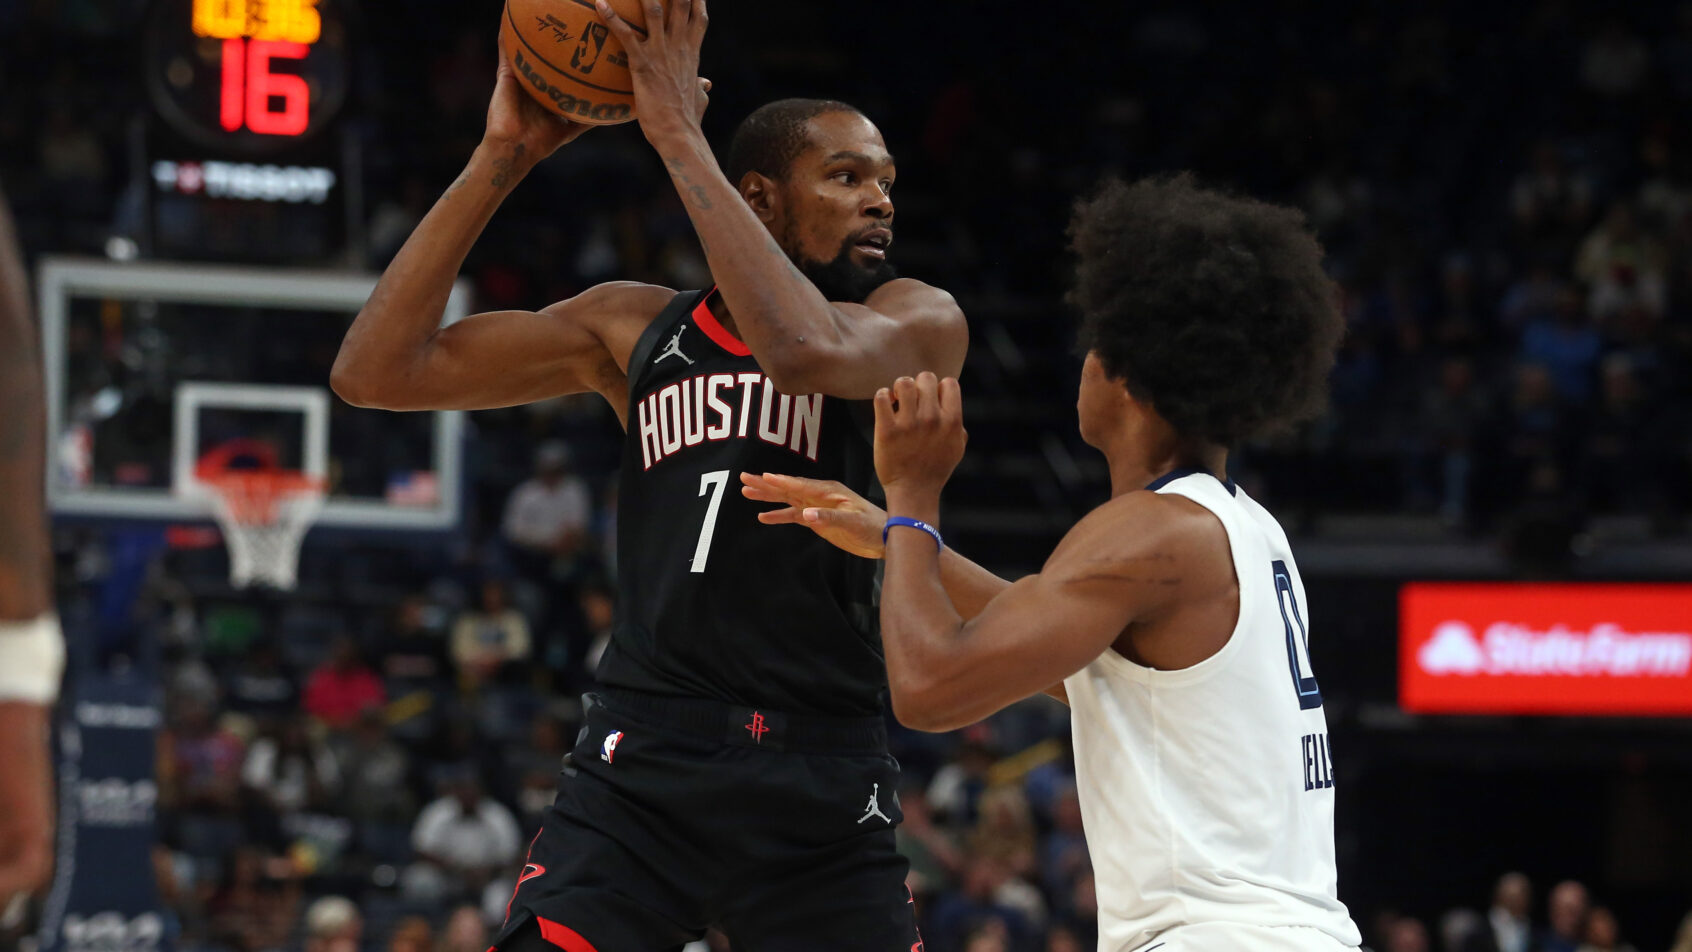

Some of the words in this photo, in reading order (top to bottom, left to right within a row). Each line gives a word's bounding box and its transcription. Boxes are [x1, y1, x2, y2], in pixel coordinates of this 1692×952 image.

[220, 38, 311, 136] 16
[638, 371, 823, 472] HOUSTON
[690, 470, 730, 573] 7
